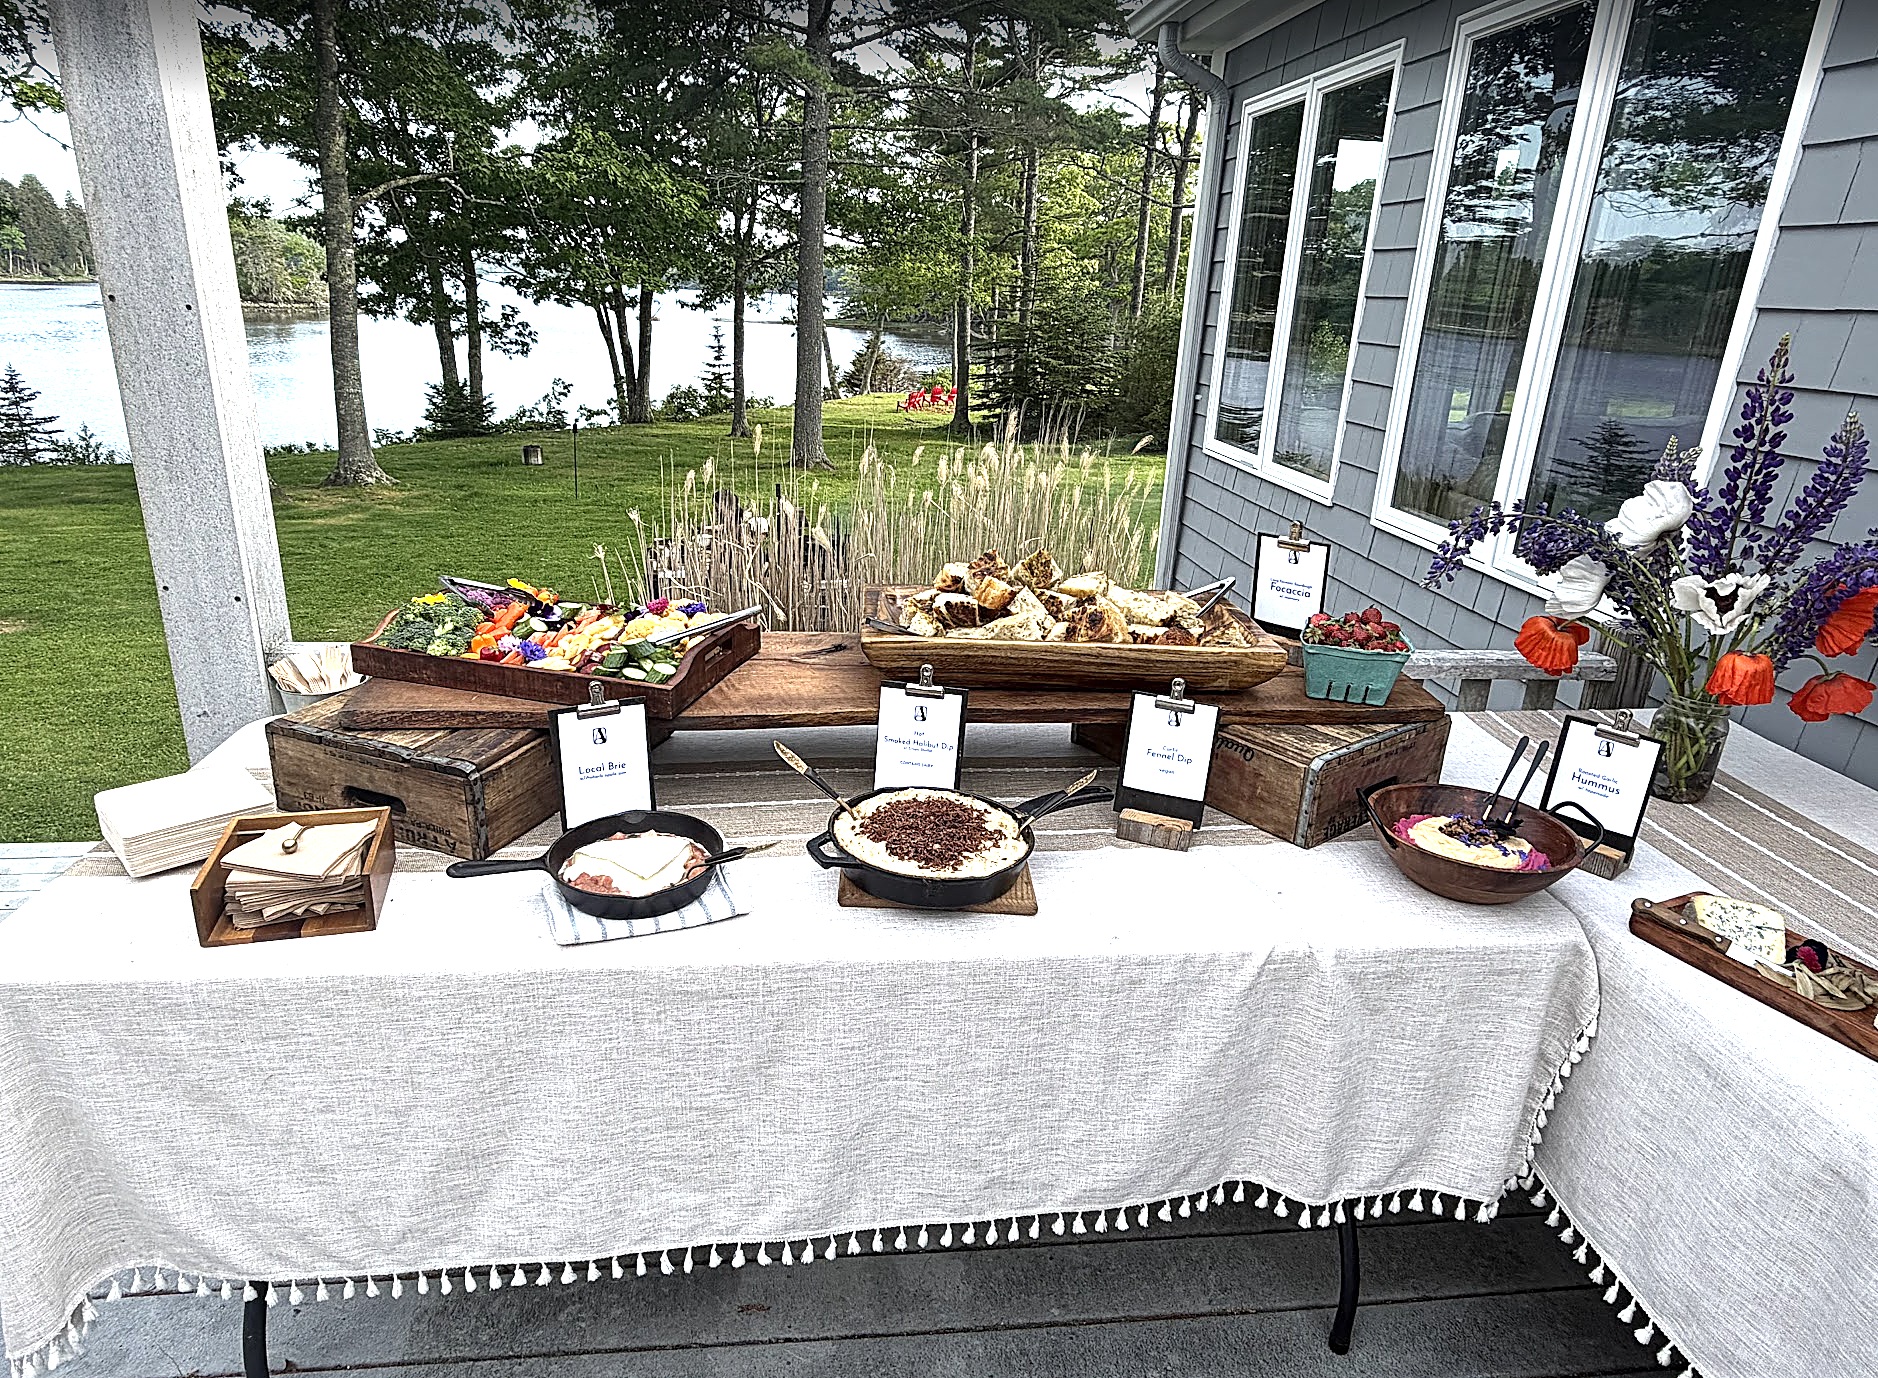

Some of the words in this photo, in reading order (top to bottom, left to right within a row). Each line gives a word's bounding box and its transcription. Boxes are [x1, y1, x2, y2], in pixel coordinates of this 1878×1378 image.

[1270, 581, 1311, 598] Focaccia
[884, 735, 911, 745] Smoked
[913, 739, 939, 749] Halibut
[941, 742, 954, 751] Dip
[1146, 748, 1175, 761] Fennel
[1177, 753, 1193, 765] Dip
[578, 762, 605, 775] Local
[608, 761, 627, 771] Brie
[1578, 767, 1601, 779] Roasted
[1601, 775, 1618, 784] Garlic
[1571, 771, 1621, 795] Hummus
[1322, 811, 1368, 839] EVERAGE
